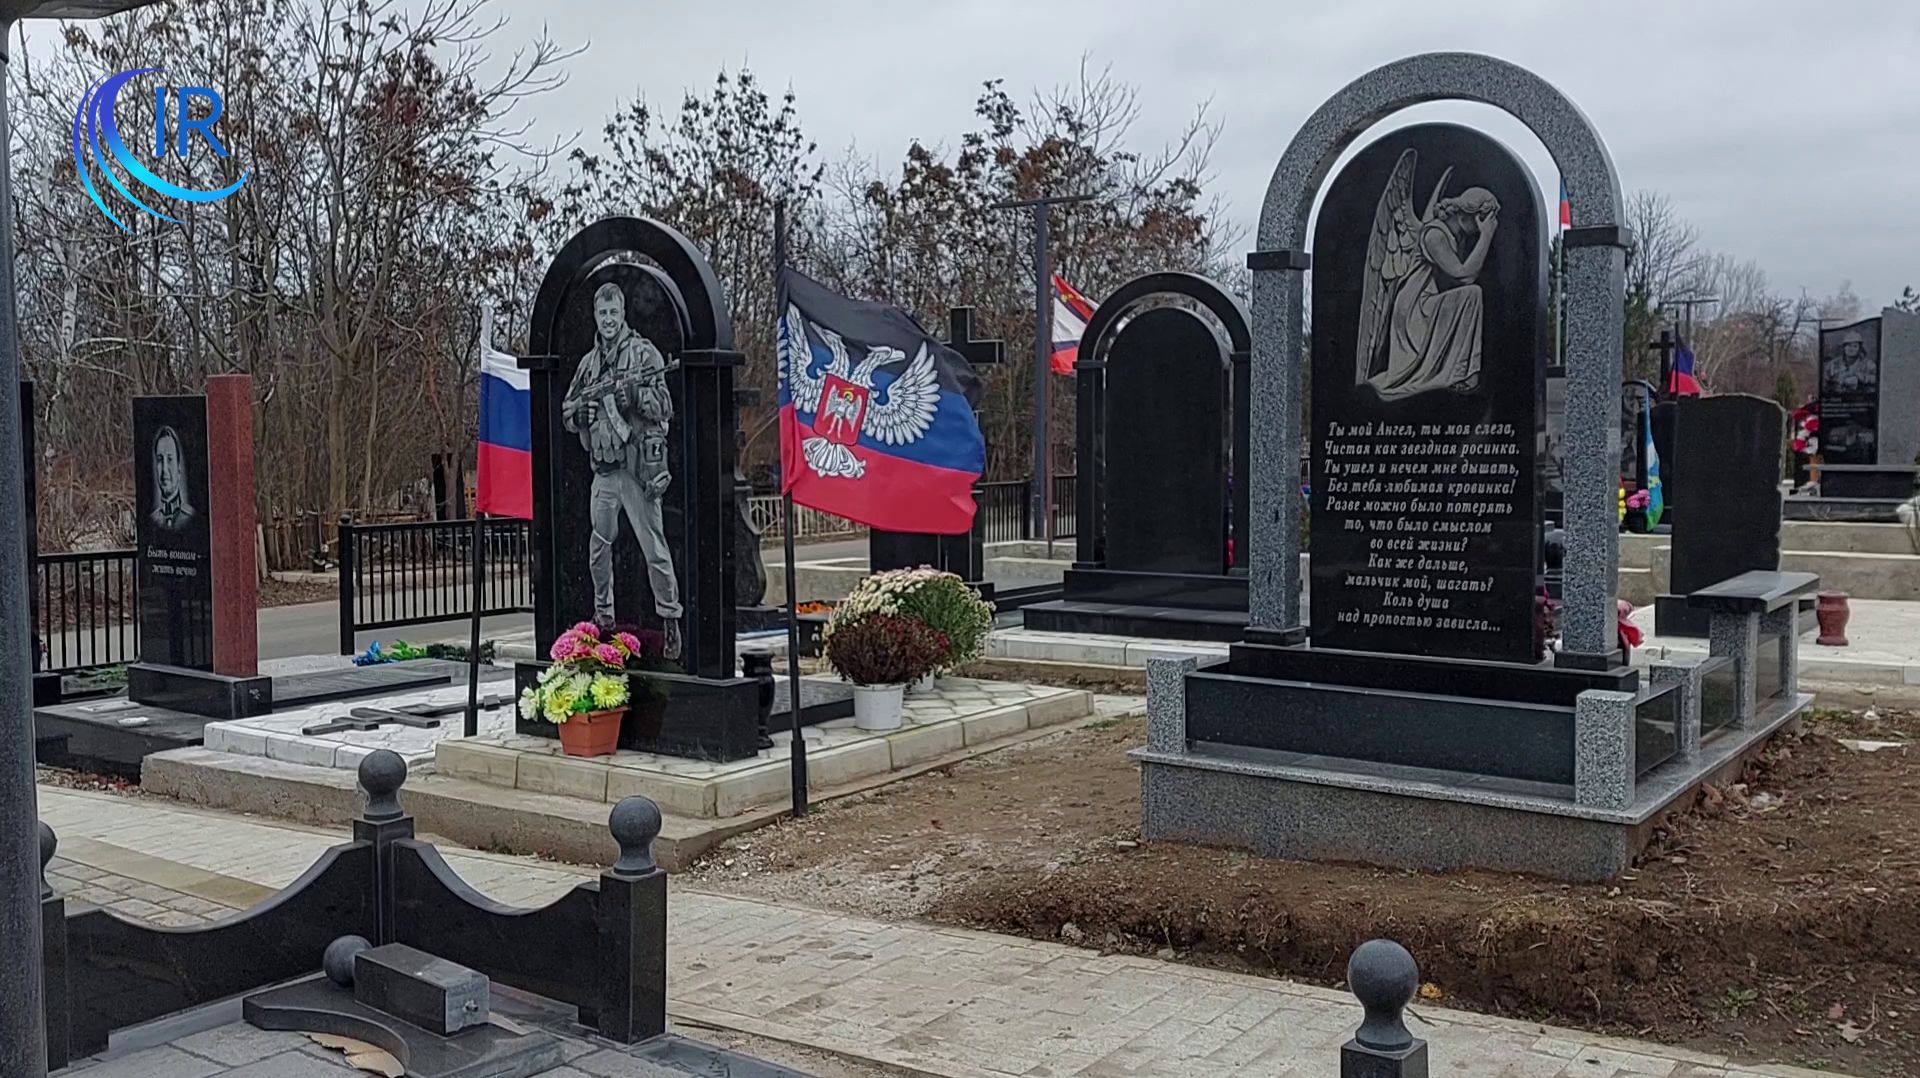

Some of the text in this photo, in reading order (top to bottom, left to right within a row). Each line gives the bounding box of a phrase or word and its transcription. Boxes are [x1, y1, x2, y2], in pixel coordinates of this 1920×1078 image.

[1329, 421, 1515, 437] Ты мой Ангел, ты моя слеза,
[1325, 440, 1520, 457] Чистая как звездная росинка.
[1324, 459, 1520, 477] Ты ушел и нечем мне дышать,
[1328, 478, 1516, 496] Без тебя любимая кровинка!
[1326, 496, 1513, 516] Разве можно было потерять
[1344, 517, 1492, 533] то, что было смыслом
[1370, 537, 1468, 552] во всей жизни?
[1368, 553, 1468, 573] Как же дальше,
[1345, 573, 1494, 591] мальчик мой, шагать?
[1383, 591, 1449, 611] Коль душа
[1337, 608, 1360, 623] над
[1436, 617, 1501, 631] зависла...
